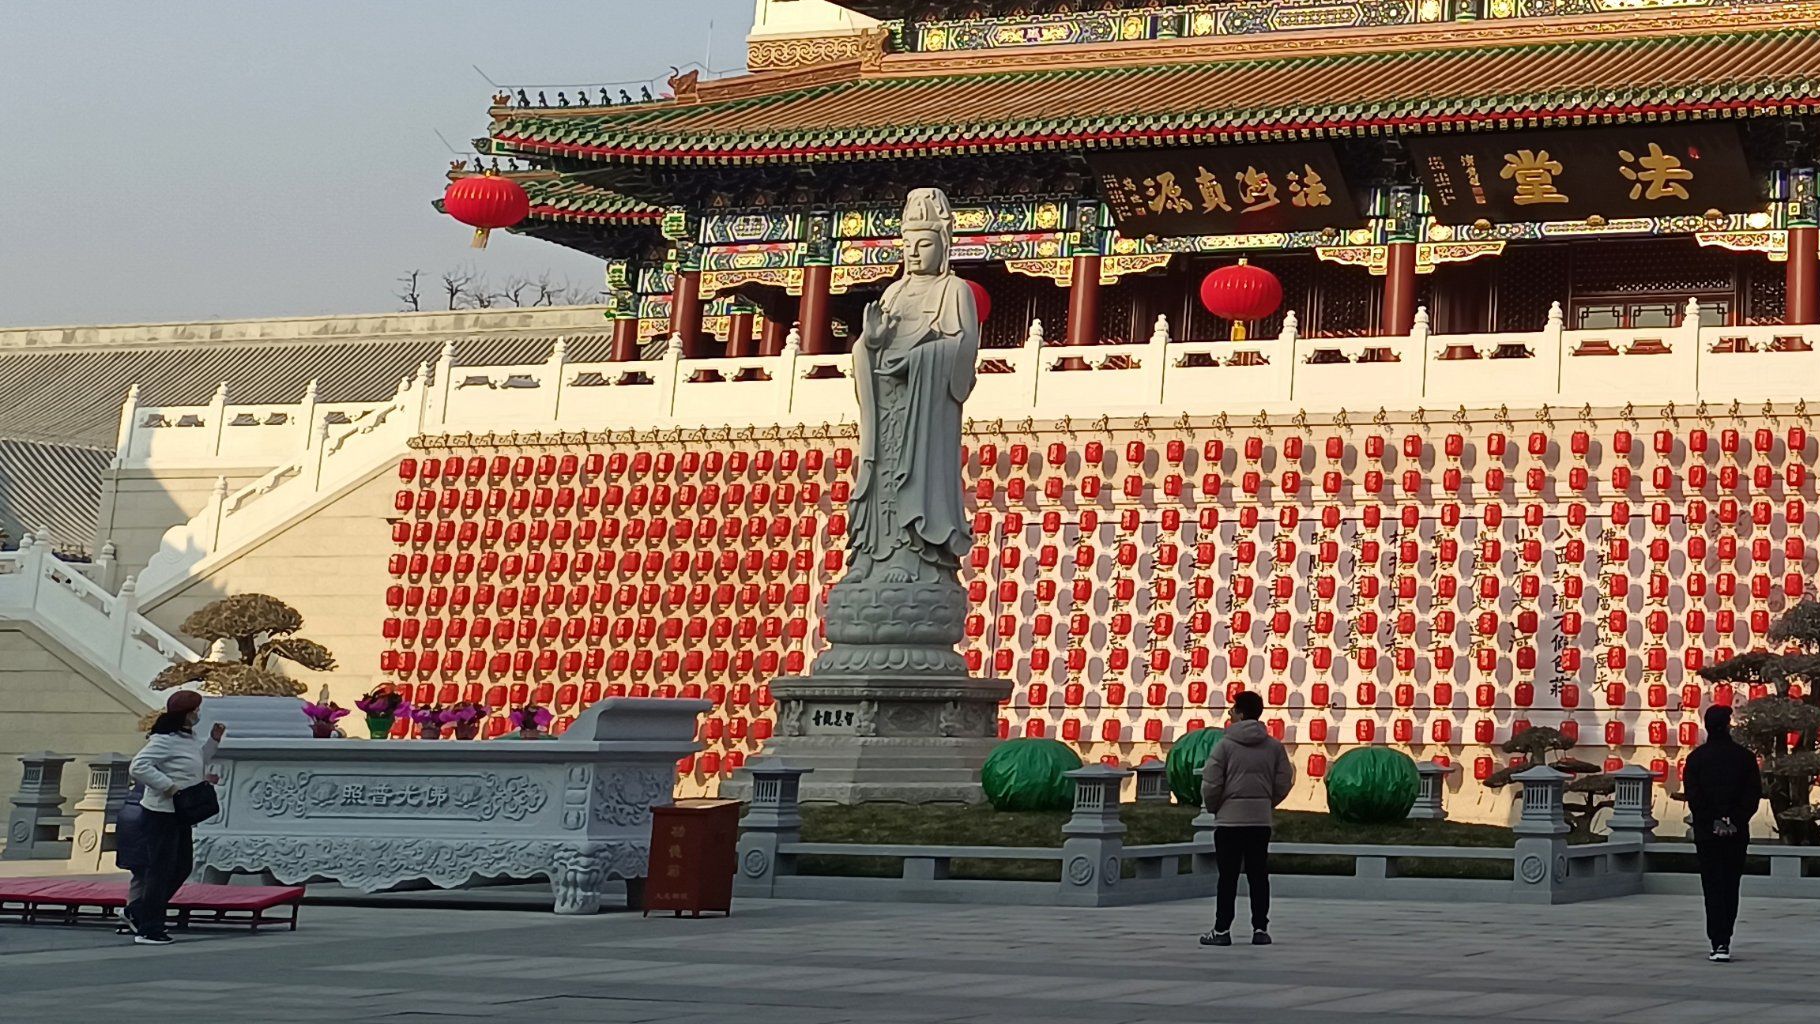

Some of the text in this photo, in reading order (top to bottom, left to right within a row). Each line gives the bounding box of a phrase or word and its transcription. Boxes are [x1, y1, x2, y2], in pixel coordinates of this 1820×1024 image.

[1500, 143, 1693, 205] 法堂
[341, 783, 449, 807] 佛光普照
